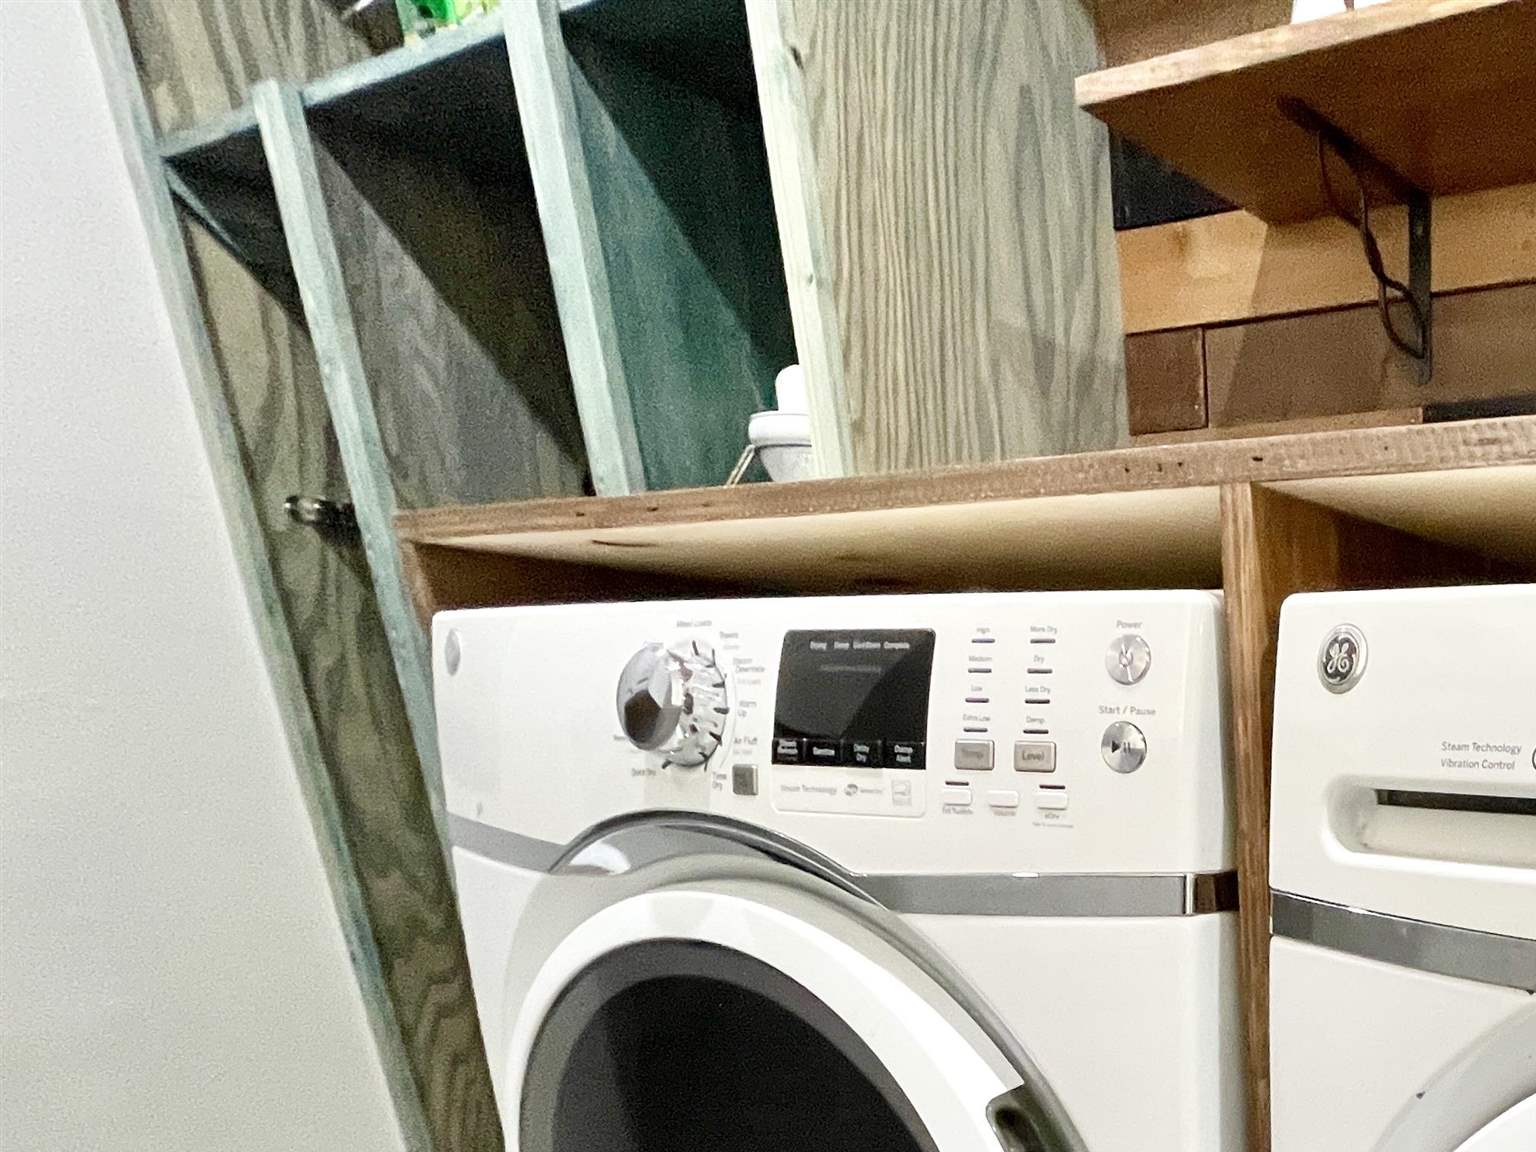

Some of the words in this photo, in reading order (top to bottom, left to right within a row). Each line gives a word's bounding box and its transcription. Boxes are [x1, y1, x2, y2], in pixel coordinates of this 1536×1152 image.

[1116, 620, 1143, 630] Power
[1033, 654, 1045, 664] Dry
[1040, 686, 1051, 694] Dry
[1098, 705, 1120, 715] Start
[1130, 706, 1157, 716] Pause
[1441, 741, 1470, 752] Steam
[1472, 742, 1522, 755] Technology
[1022, 750, 1045, 761] Level
[1441, 759, 1479, 769] Vibration
[1482, 760, 1515, 770] Control
